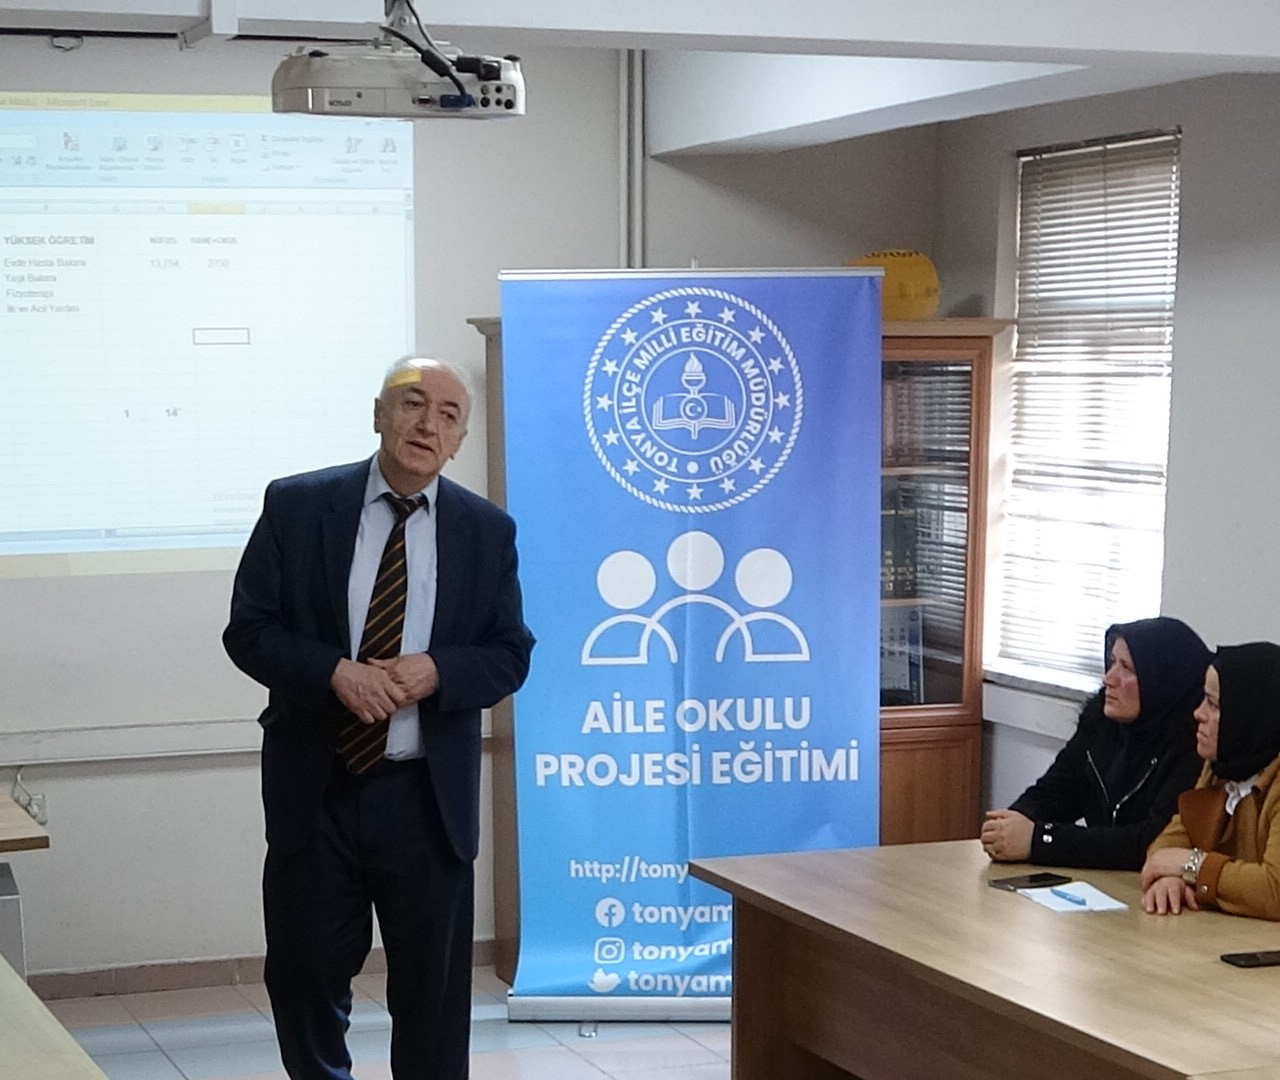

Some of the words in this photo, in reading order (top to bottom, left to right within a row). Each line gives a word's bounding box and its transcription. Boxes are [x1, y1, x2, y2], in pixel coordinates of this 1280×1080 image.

[634, 326, 678, 372] MİLLİ
[680, 322, 745, 362] EĞİTİM
[618, 369, 642, 414] İLÇE
[709, 356, 769, 474] MÜDÜRLÜĞÜ
[628, 417, 679, 474] TONYA
[580, 691, 666, 735] AİLE
[675, 696, 811, 733] OKULU
[535, 743, 701, 787] PROJESİ
[711, 738, 860, 785] EĞİTİMİ
